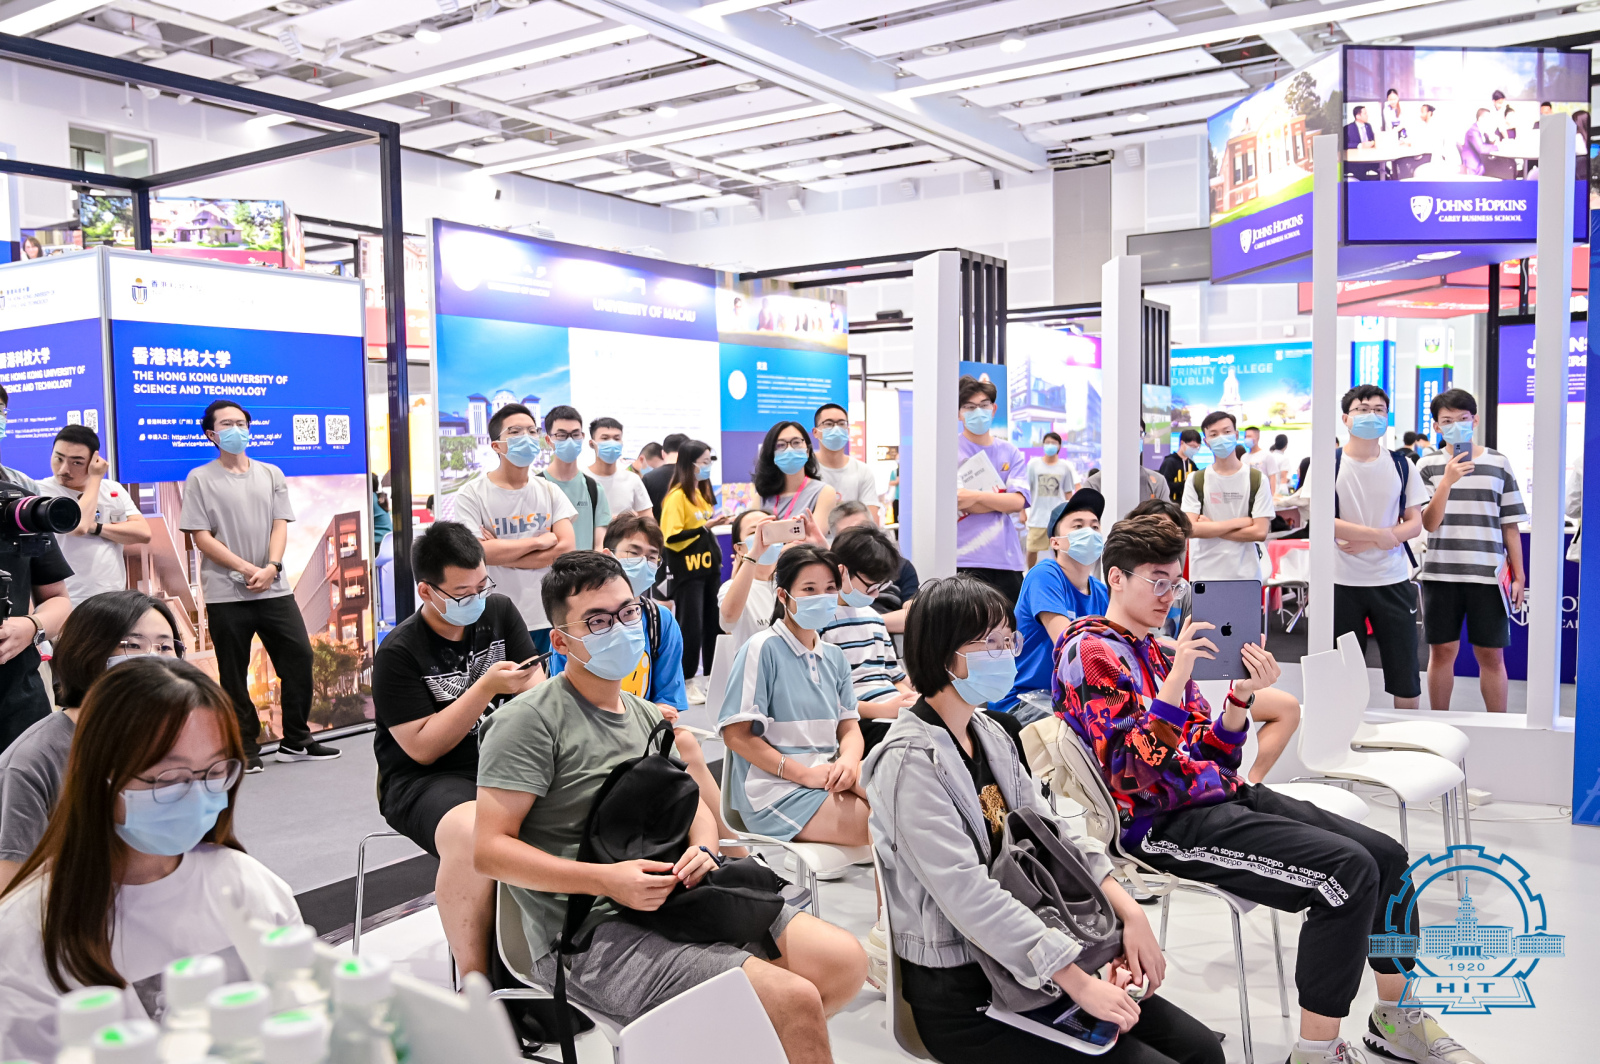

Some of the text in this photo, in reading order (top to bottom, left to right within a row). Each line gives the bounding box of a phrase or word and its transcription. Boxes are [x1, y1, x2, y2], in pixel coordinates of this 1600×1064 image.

[1434, 197, 1527, 214] JOHNS HOPKINS
[1438, 214, 1461, 222] CAREY
[1252, 213, 1304, 244] JOHNS HOPKINS
[592, 297, 696, 323] UNIVERSITY OF MACAU
[132, 346, 231, 368] 香港科技大学
[10, 371, 27, 381] HONG
[43, 366, 76, 378] UNIVERSITY
[77, 365, 86, 375] OF
[132, 371, 288, 385] THE HONG KONG UNIVERSITY OF
[1171, 366, 1217, 377] TRINITY
[22, 382, 34, 392] AND
[34, 379, 72, 391] TECHNOLOGY
[1171, 376, 1214, 386] DUBLIN
[133, 384, 267, 396] SCIENCE AND TECHNOLOGY
[1220, 847, 1245, 858] adidas
[1258, 856, 1284, 868] adidas
[1298, 867, 1327, 880] adidas
[1256, 863, 1283, 876] adidas
[1327, 875, 1349, 900] adidas
